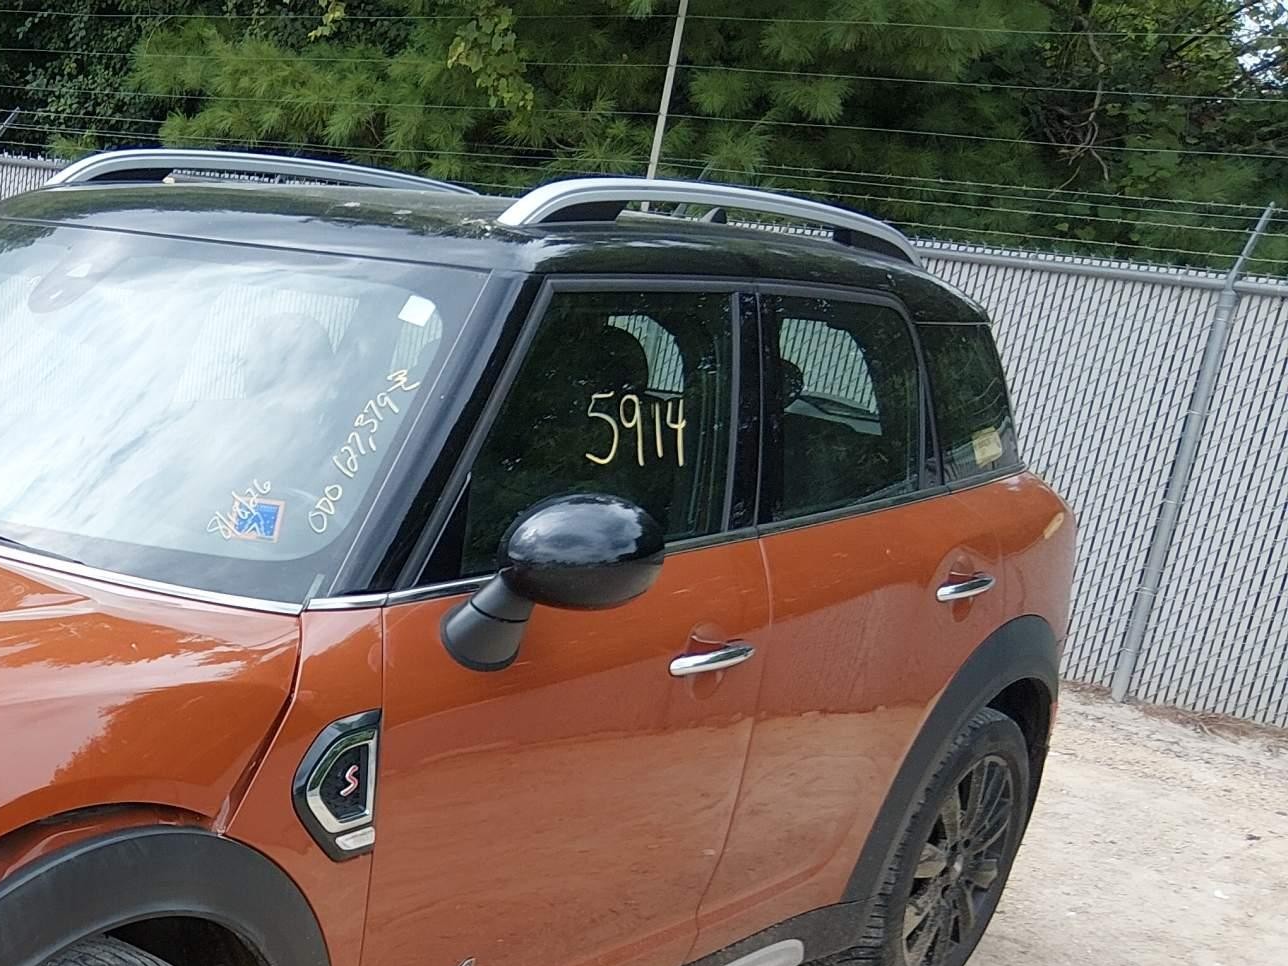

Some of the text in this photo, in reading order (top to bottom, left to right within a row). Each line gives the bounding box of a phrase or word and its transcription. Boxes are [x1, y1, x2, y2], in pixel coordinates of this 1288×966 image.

[308, 392, 400, 533] ODO 127,379
[585, 391, 687, 467] 5914
[206, 479, 272, 540] 8/18/26
[339, 765, 359, 797] S
